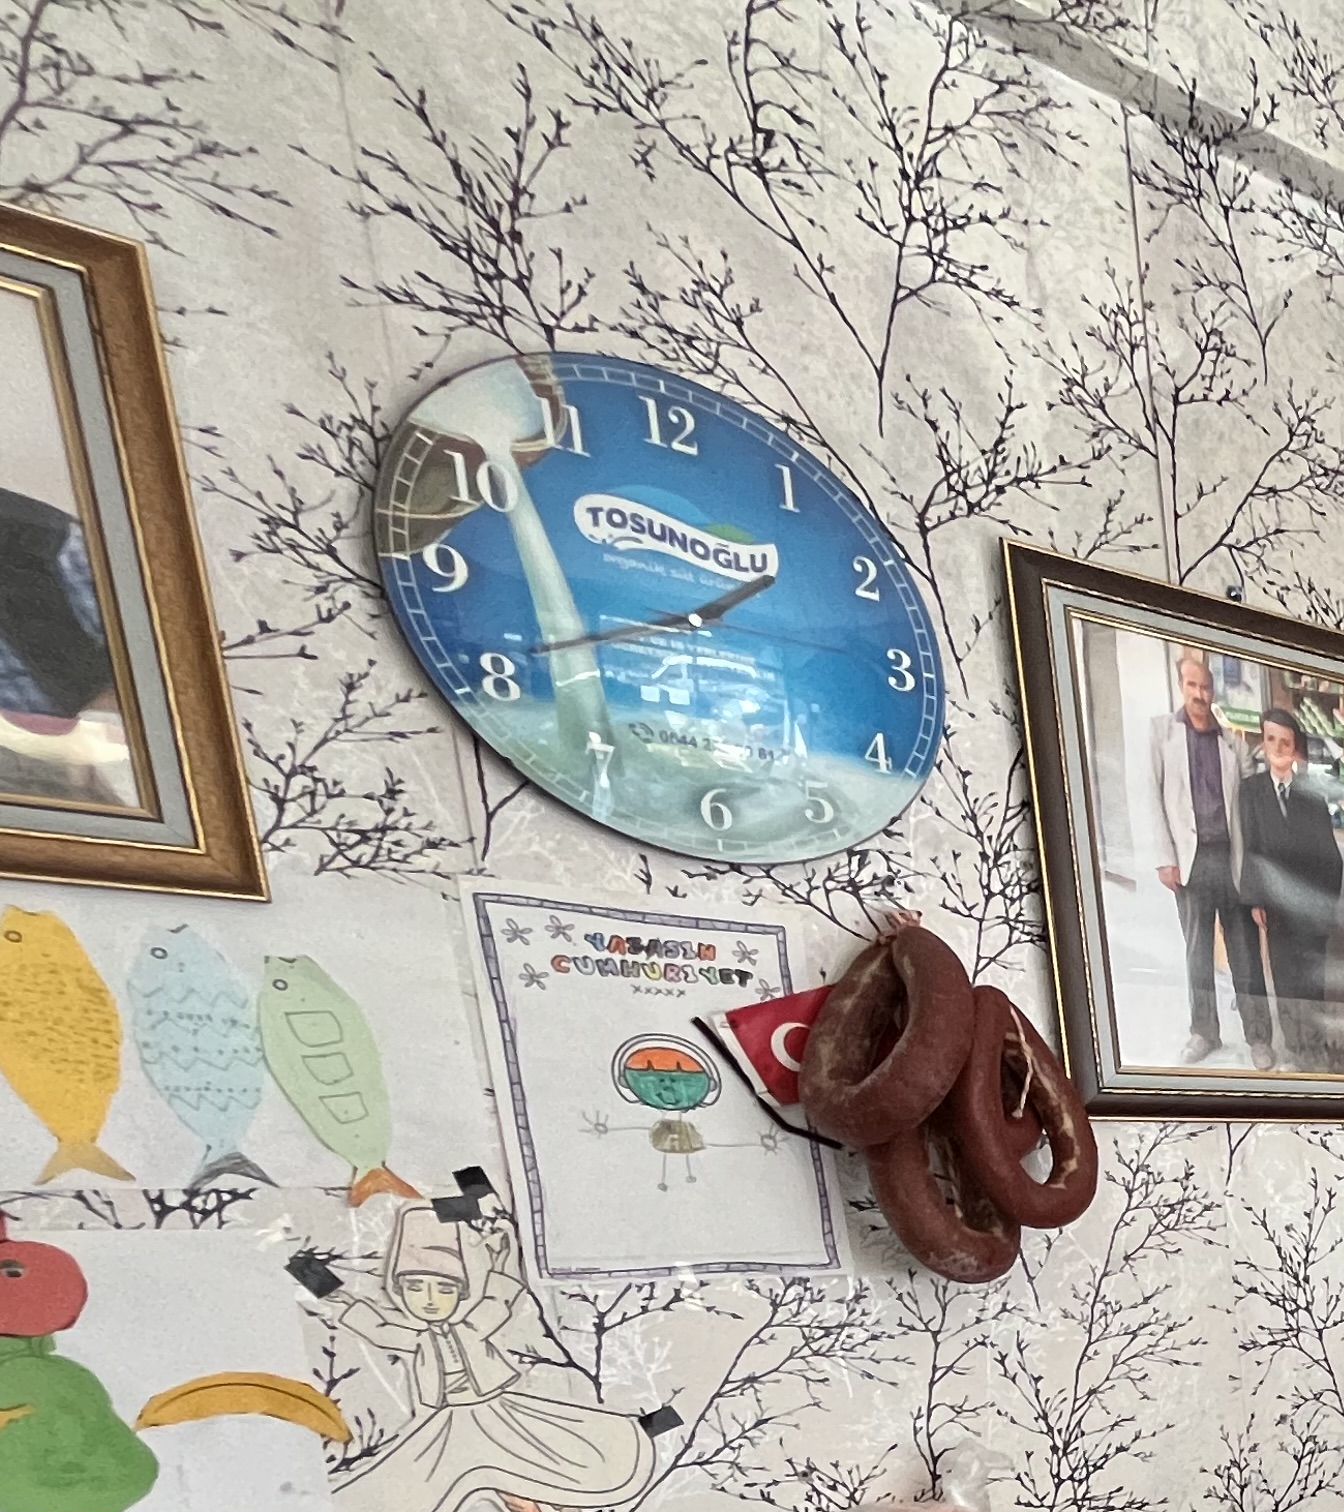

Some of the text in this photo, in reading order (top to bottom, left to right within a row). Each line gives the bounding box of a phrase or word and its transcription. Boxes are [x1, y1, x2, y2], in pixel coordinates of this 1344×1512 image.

[538, 397, 590, 458] 11
[639, 395, 699, 456] 12
[446, 450, 518, 513] 10
[775, 464, 800, 514] 1
[586, 507, 767, 573] TOSUNOĞLU
[421, 543, 469, 593] 9
[852, 556, 881, 602] 2
[478, 652, 521, 701] 8
[885, 648, 916, 693] 3
[863, 732, 893, 775] 4
[700, 788, 734, 832] 6
[800, 779, 836, 824] 5
